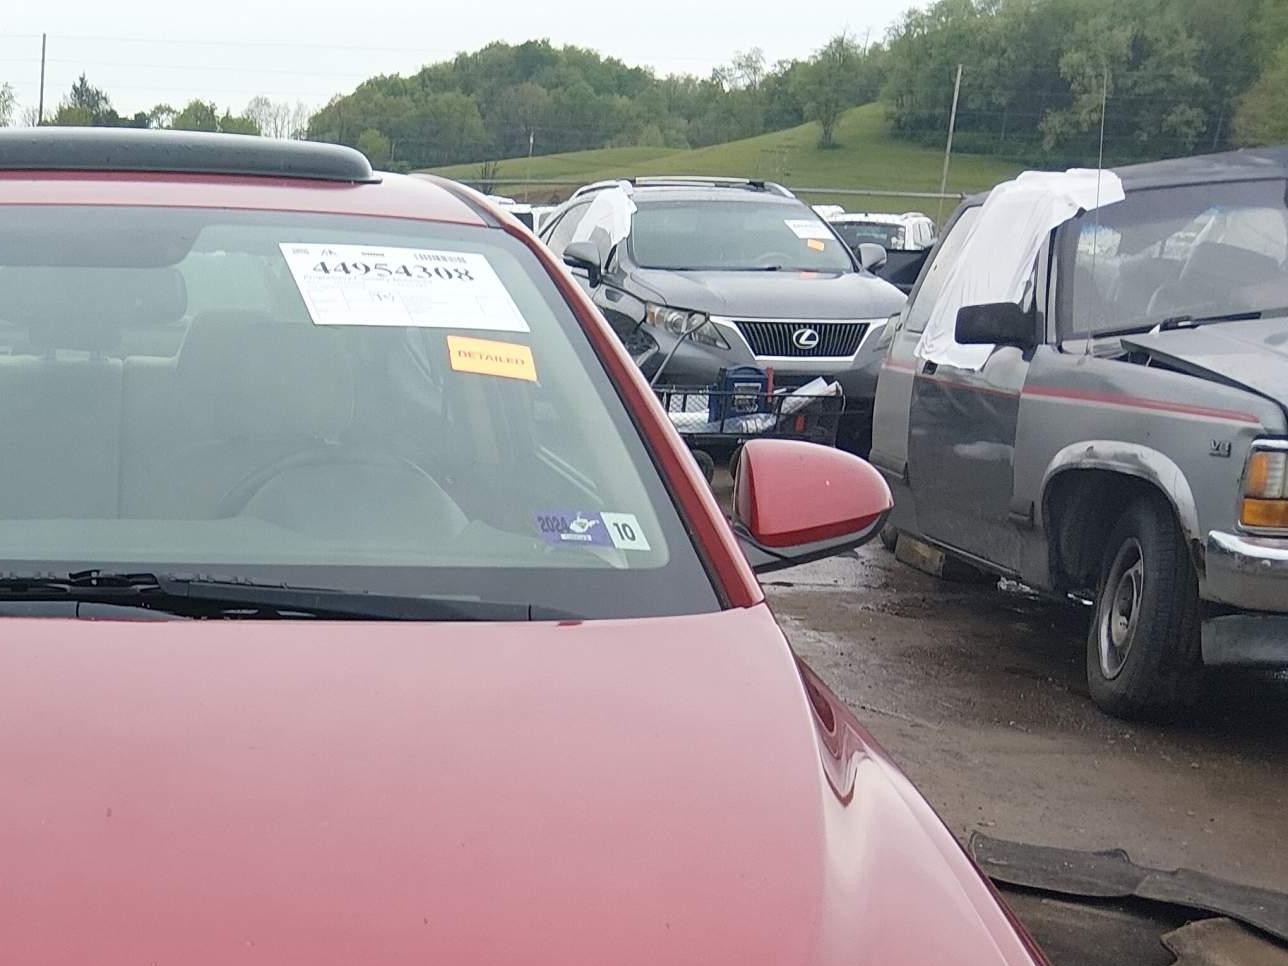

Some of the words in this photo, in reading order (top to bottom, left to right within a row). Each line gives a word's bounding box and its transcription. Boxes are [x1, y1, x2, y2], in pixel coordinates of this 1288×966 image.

[312, 261, 475, 282] 44954308
[457, 350, 525, 365] DETAILED
[612, 522, 636, 541] 10
